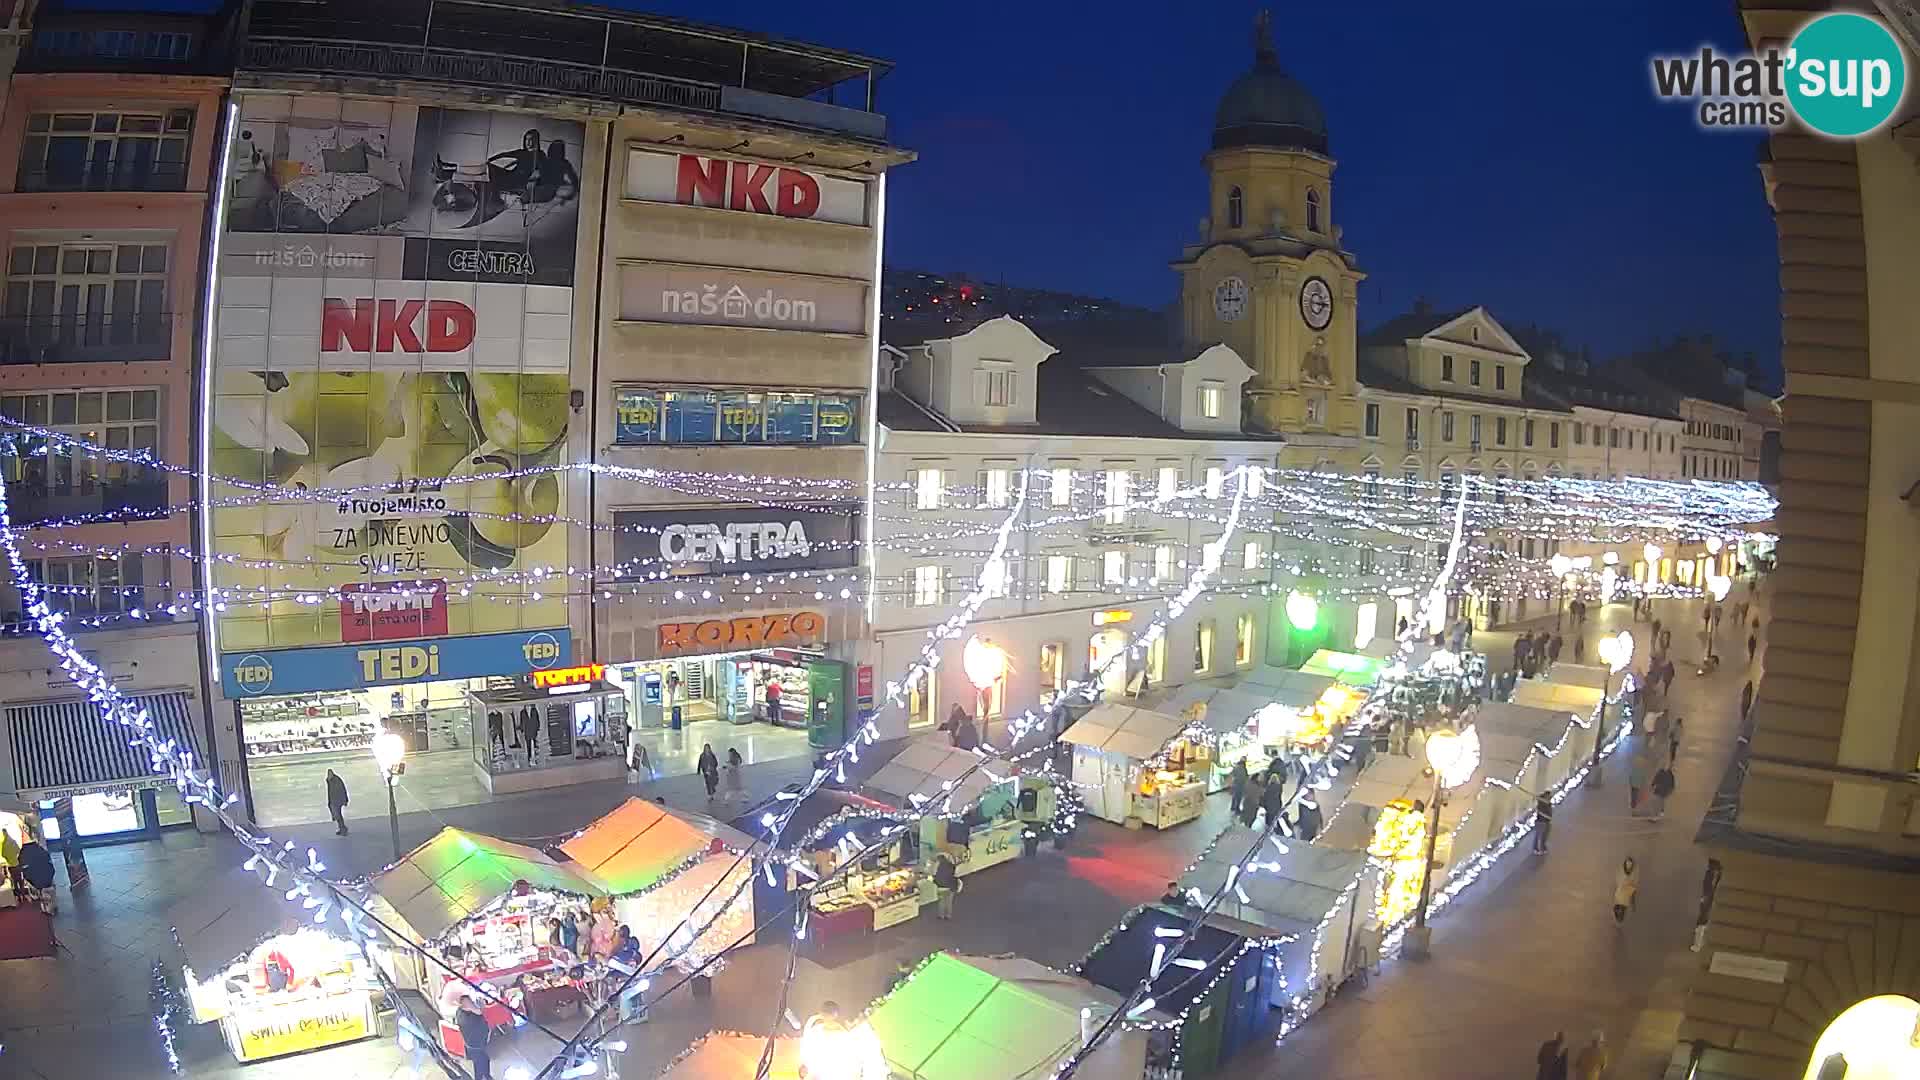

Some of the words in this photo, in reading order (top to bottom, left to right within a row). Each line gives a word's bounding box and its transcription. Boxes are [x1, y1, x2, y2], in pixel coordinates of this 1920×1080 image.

[676, 154, 821, 218] NKD
[256, 246, 292, 267] naš
[321, 246, 367, 270] dom
[448, 249, 535, 275] CENTRA
[662, 284, 718, 317] naš
[754, 289, 816, 323] dom
[321, 297, 477, 353] NKD
[338, 497, 446, 516] #TvojeMisto
[333, 527, 358, 549] ZA
[366, 522, 450, 547] DNEVNO
[660, 521, 810, 563] CENTRA
[359, 546, 426, 575] SVJEŽE
[660, 611, 826, 652] KORZO
[358, 644, 439, 682] TEDi
[522, 642, 560, 660] TEDi
[233, 665, 273, 683] TEDi
